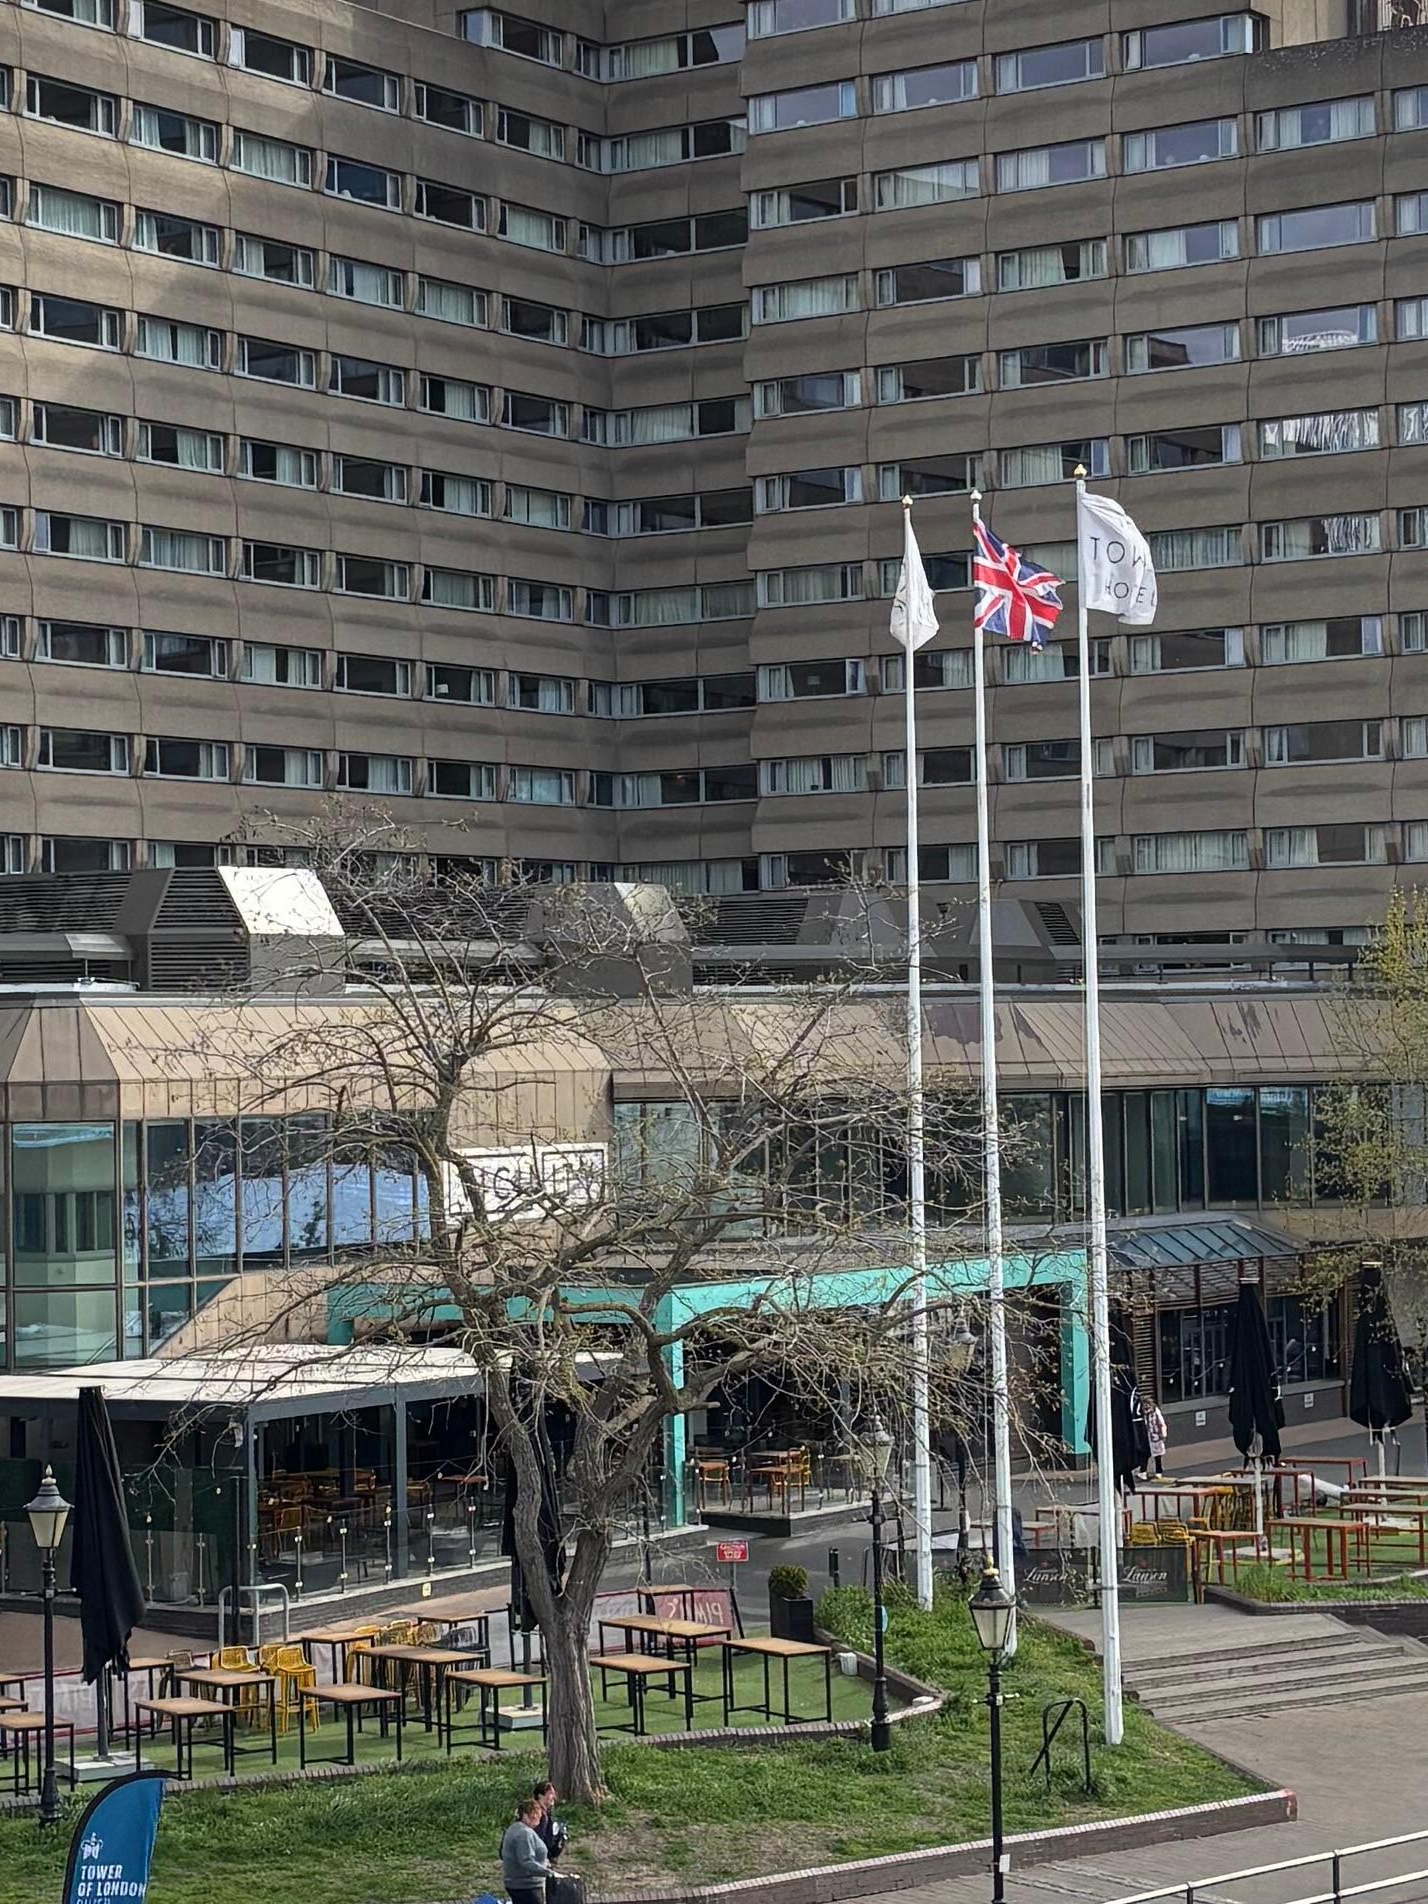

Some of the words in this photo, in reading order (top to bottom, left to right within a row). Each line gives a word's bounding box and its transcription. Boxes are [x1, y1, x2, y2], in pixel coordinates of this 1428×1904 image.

[80, 1865, 123, 1880] TOWER
[77, 1882, 93, 1897] OF
[96, 1881, 145, 1897] LONDON
